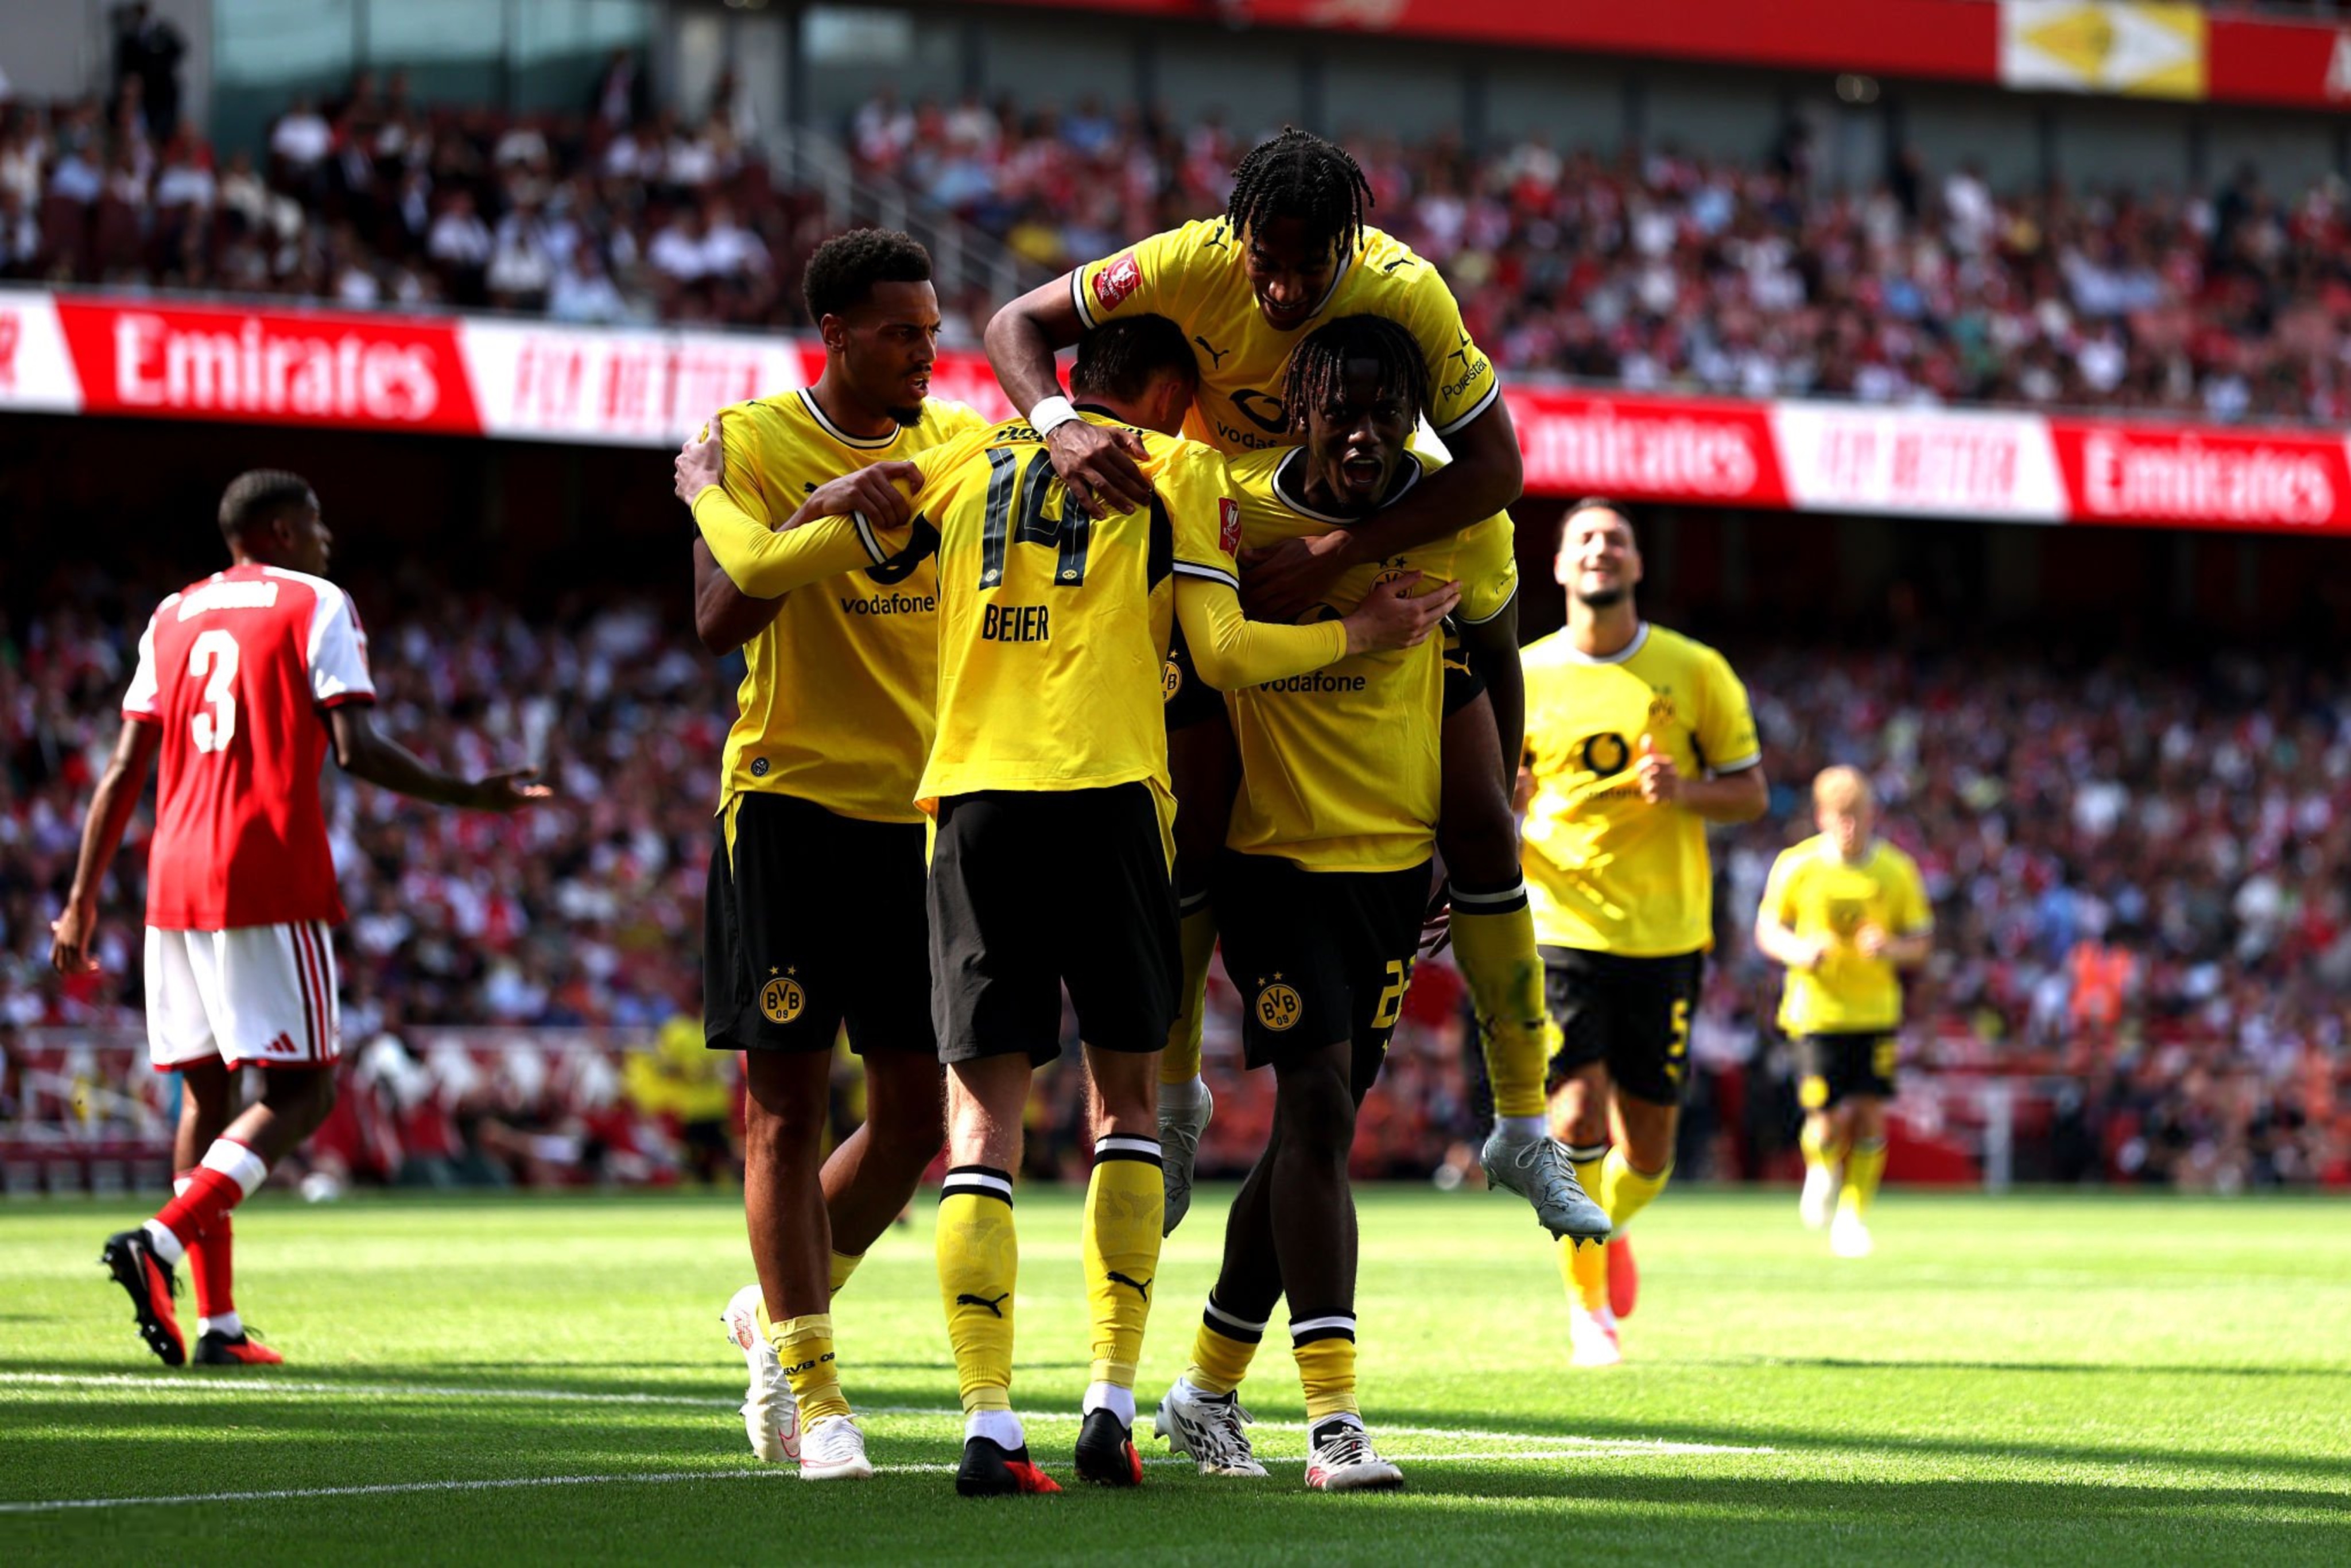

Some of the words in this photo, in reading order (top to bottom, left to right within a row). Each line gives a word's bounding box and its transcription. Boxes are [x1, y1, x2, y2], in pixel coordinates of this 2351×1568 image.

[115, 313, 439, 421] Emirates
[1442, 358, 1487, 402] Polestar
[2084, 428, 2334, 524] Emirates
[979, 447, 1091, 591] 14
[841, 593, 935, 615] vodafone
[982, 603, 1049, 642] BEIER
[189, 629, 239, 753] 3
[1259, 671, 1366, 692] vodafone
[767, 983, 800, 1010] BVB
[776, 1010, 788, 1019] 09
[1262, 988, 1297, 1021] BVB
[783, 1360, 816, 1375] BVB
